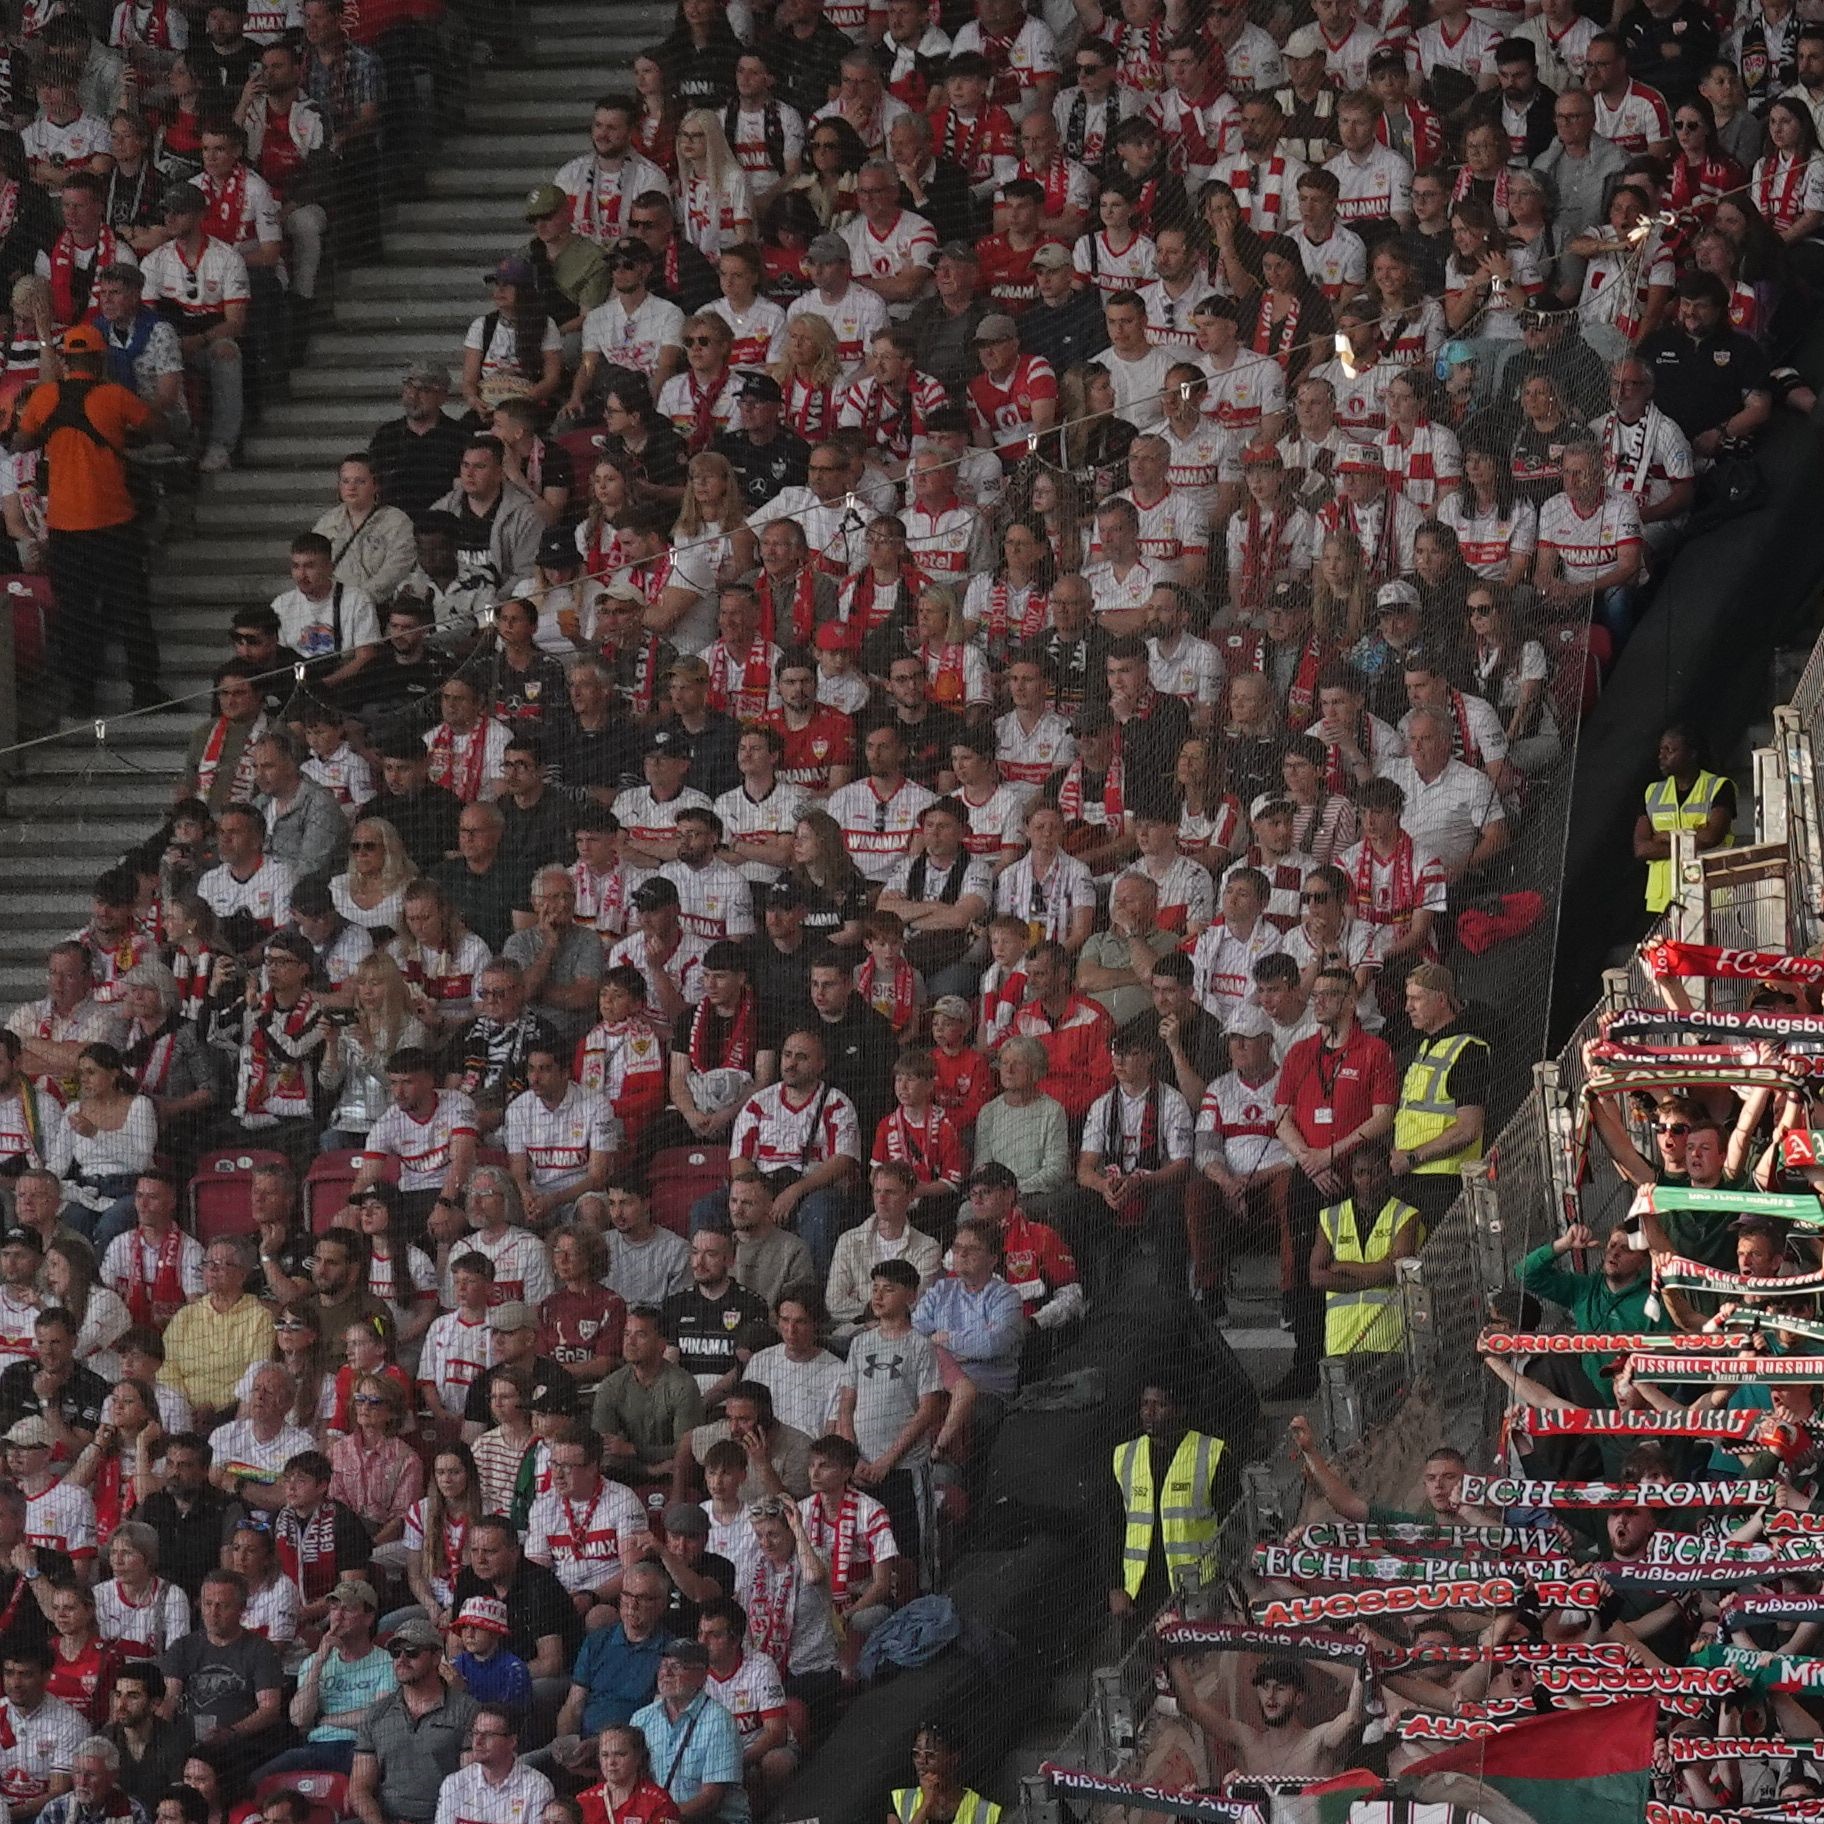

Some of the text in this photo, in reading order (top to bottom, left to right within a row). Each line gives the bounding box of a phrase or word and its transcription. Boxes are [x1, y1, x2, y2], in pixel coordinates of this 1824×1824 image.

[1716, 950, 1754, 972] FC
[1488, 1336, 1648, 1352] ORIGINAL
[1536, 1409, 1748, 1433] FC AUGSBURG
[1620, 1564, 1740, 1583] Fußball-Club
[1263, 1582, 1516, 1626] AUGSBURG
